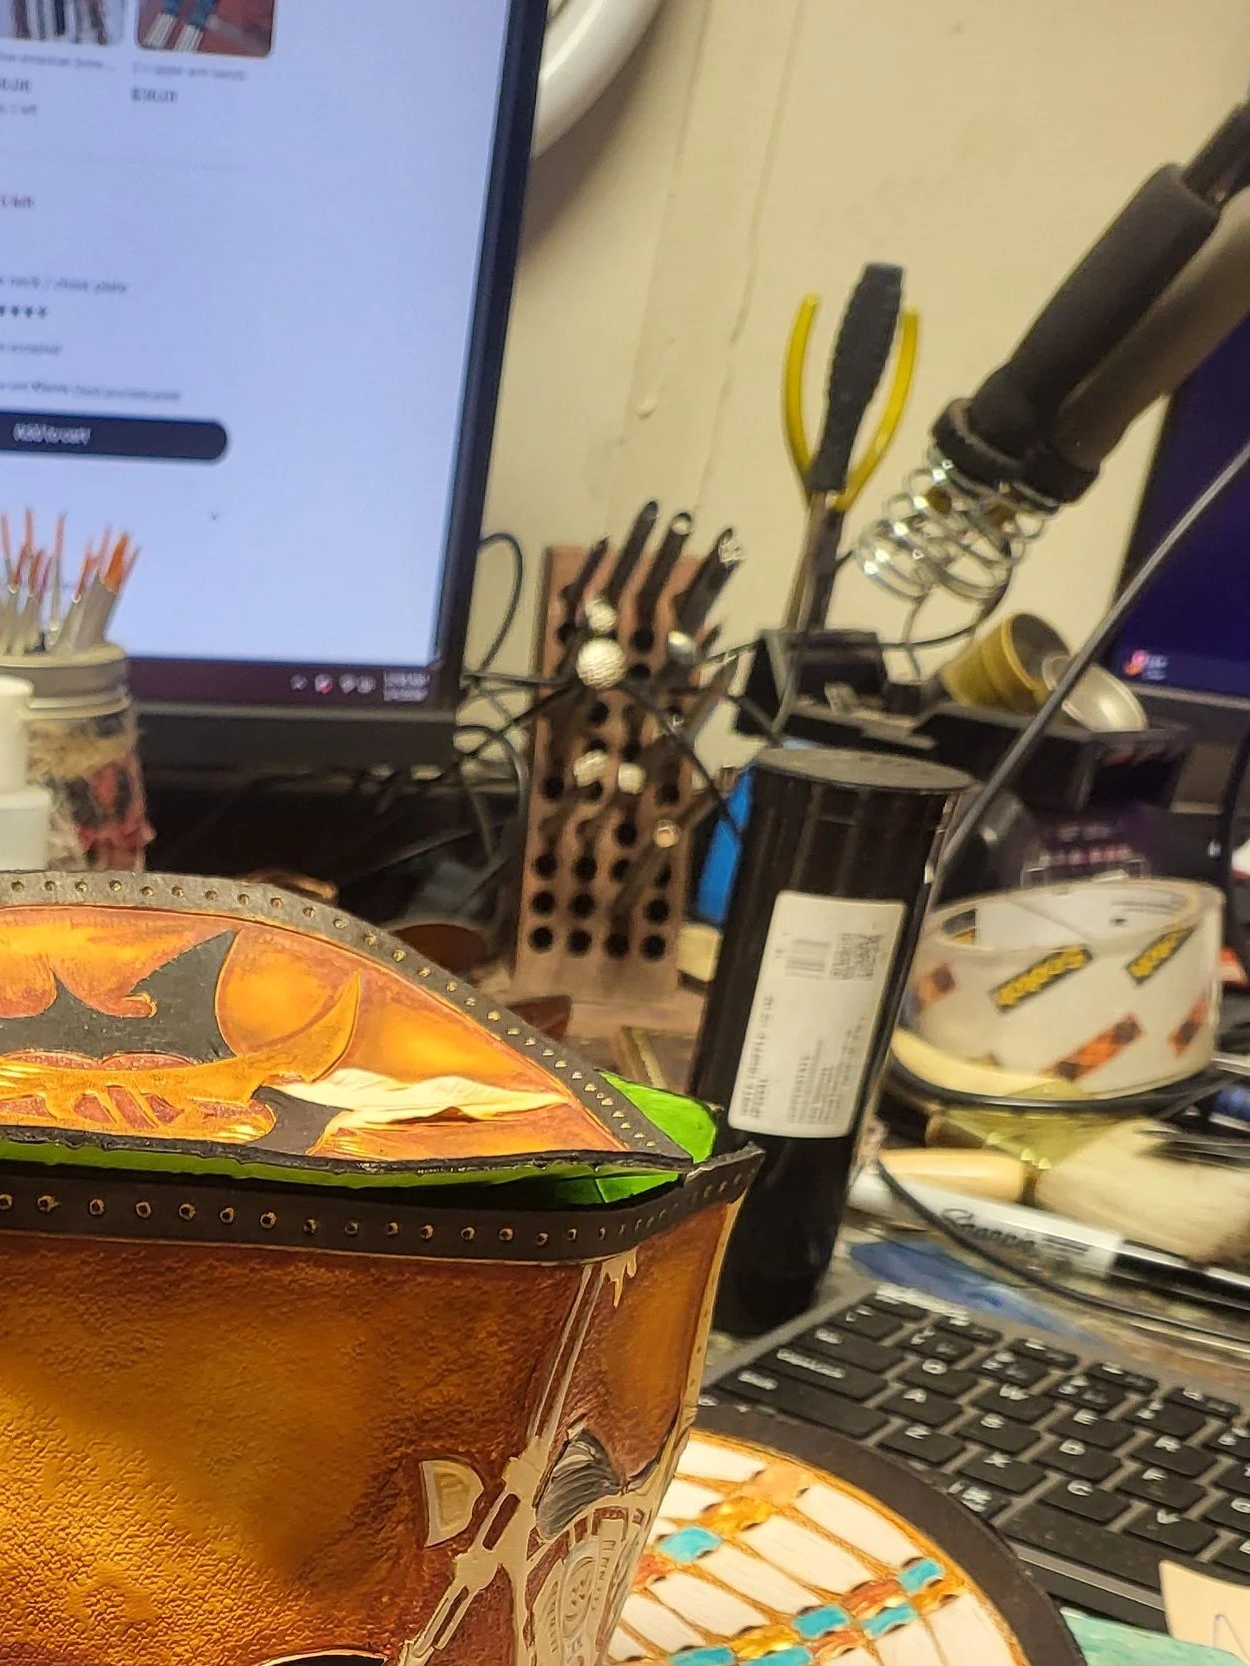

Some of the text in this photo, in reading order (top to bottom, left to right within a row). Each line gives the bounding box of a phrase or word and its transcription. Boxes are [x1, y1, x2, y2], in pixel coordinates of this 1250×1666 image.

[1073, 1407, 1100, 1426] E
[904, 1424, 931, 1440] Z
[984, 1451, 1012, 1469] X
[1067, 1479, 1094, 1497] C
[1156, 1507, 1181, 1525] V
